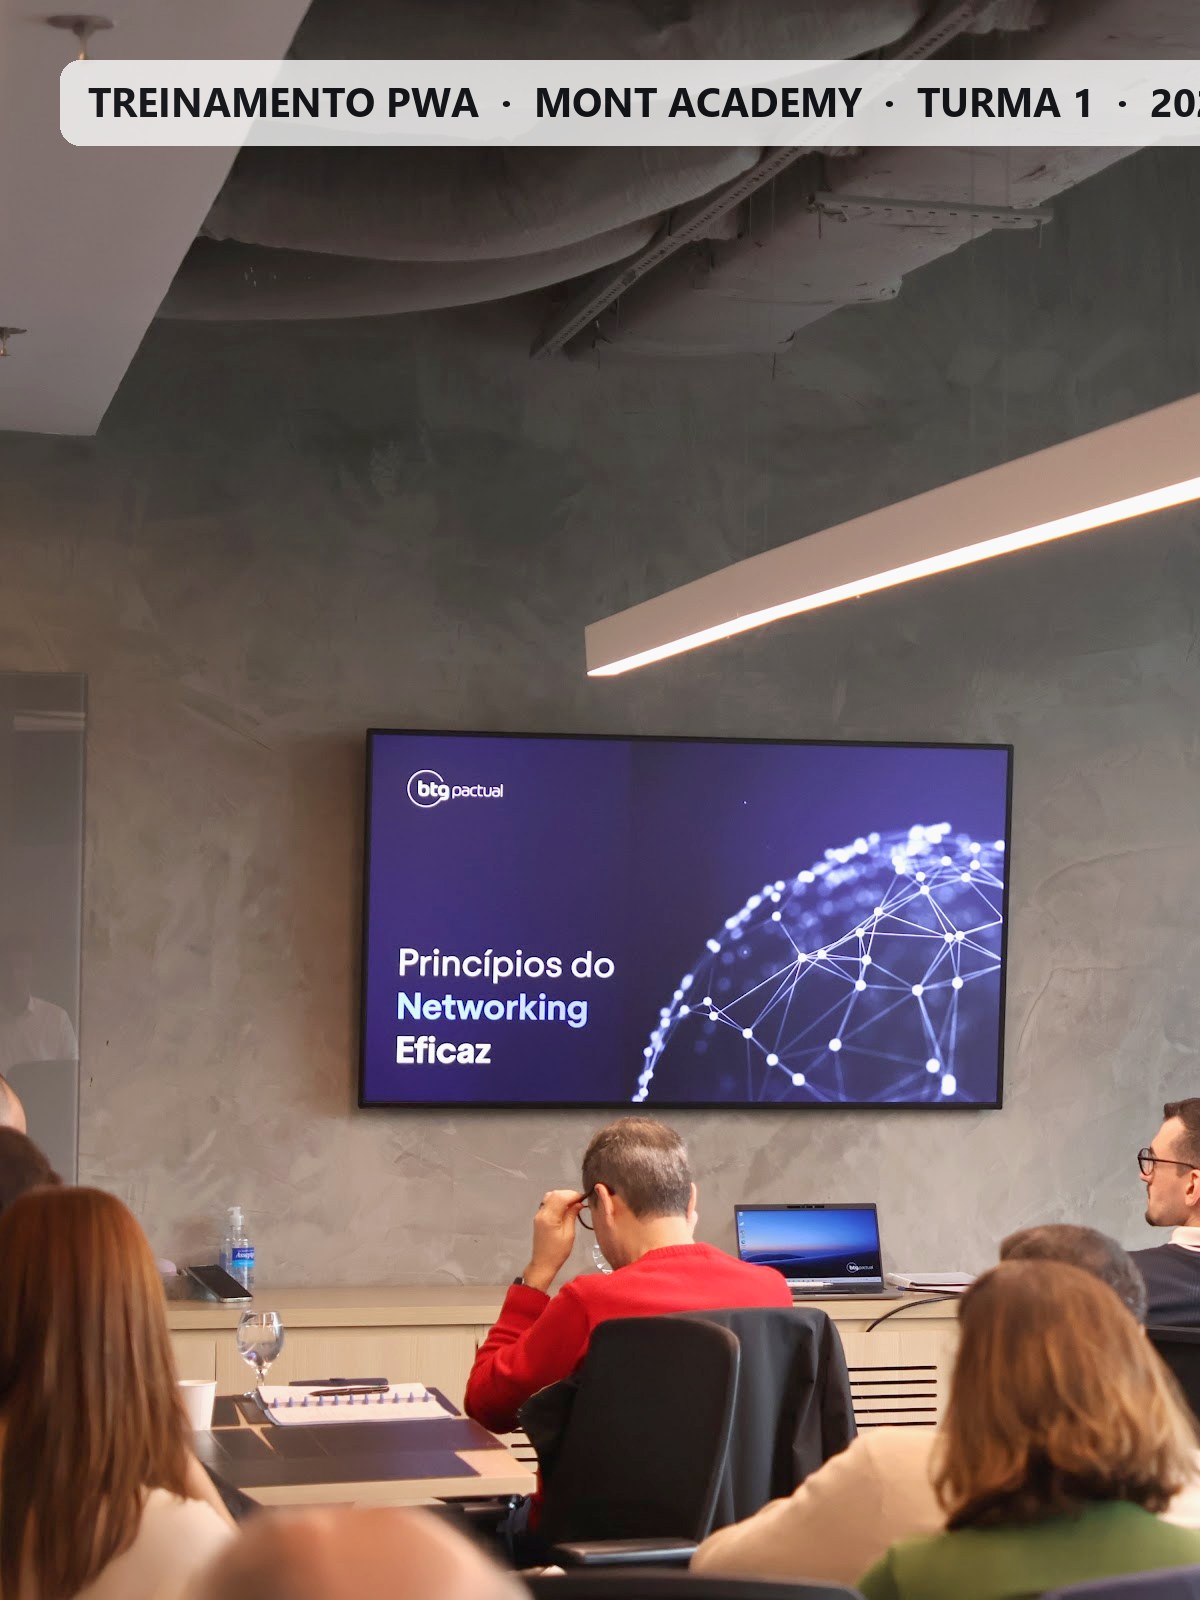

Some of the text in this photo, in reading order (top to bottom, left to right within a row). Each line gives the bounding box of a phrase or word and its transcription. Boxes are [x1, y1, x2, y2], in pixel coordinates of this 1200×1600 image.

[417, 780, 504, 801] btg pactual
[399, 948, 615, 984] Princípios do
[397, 992, 588, 1028] Networking
[396, 1035, 491, 1064] Eficaz
